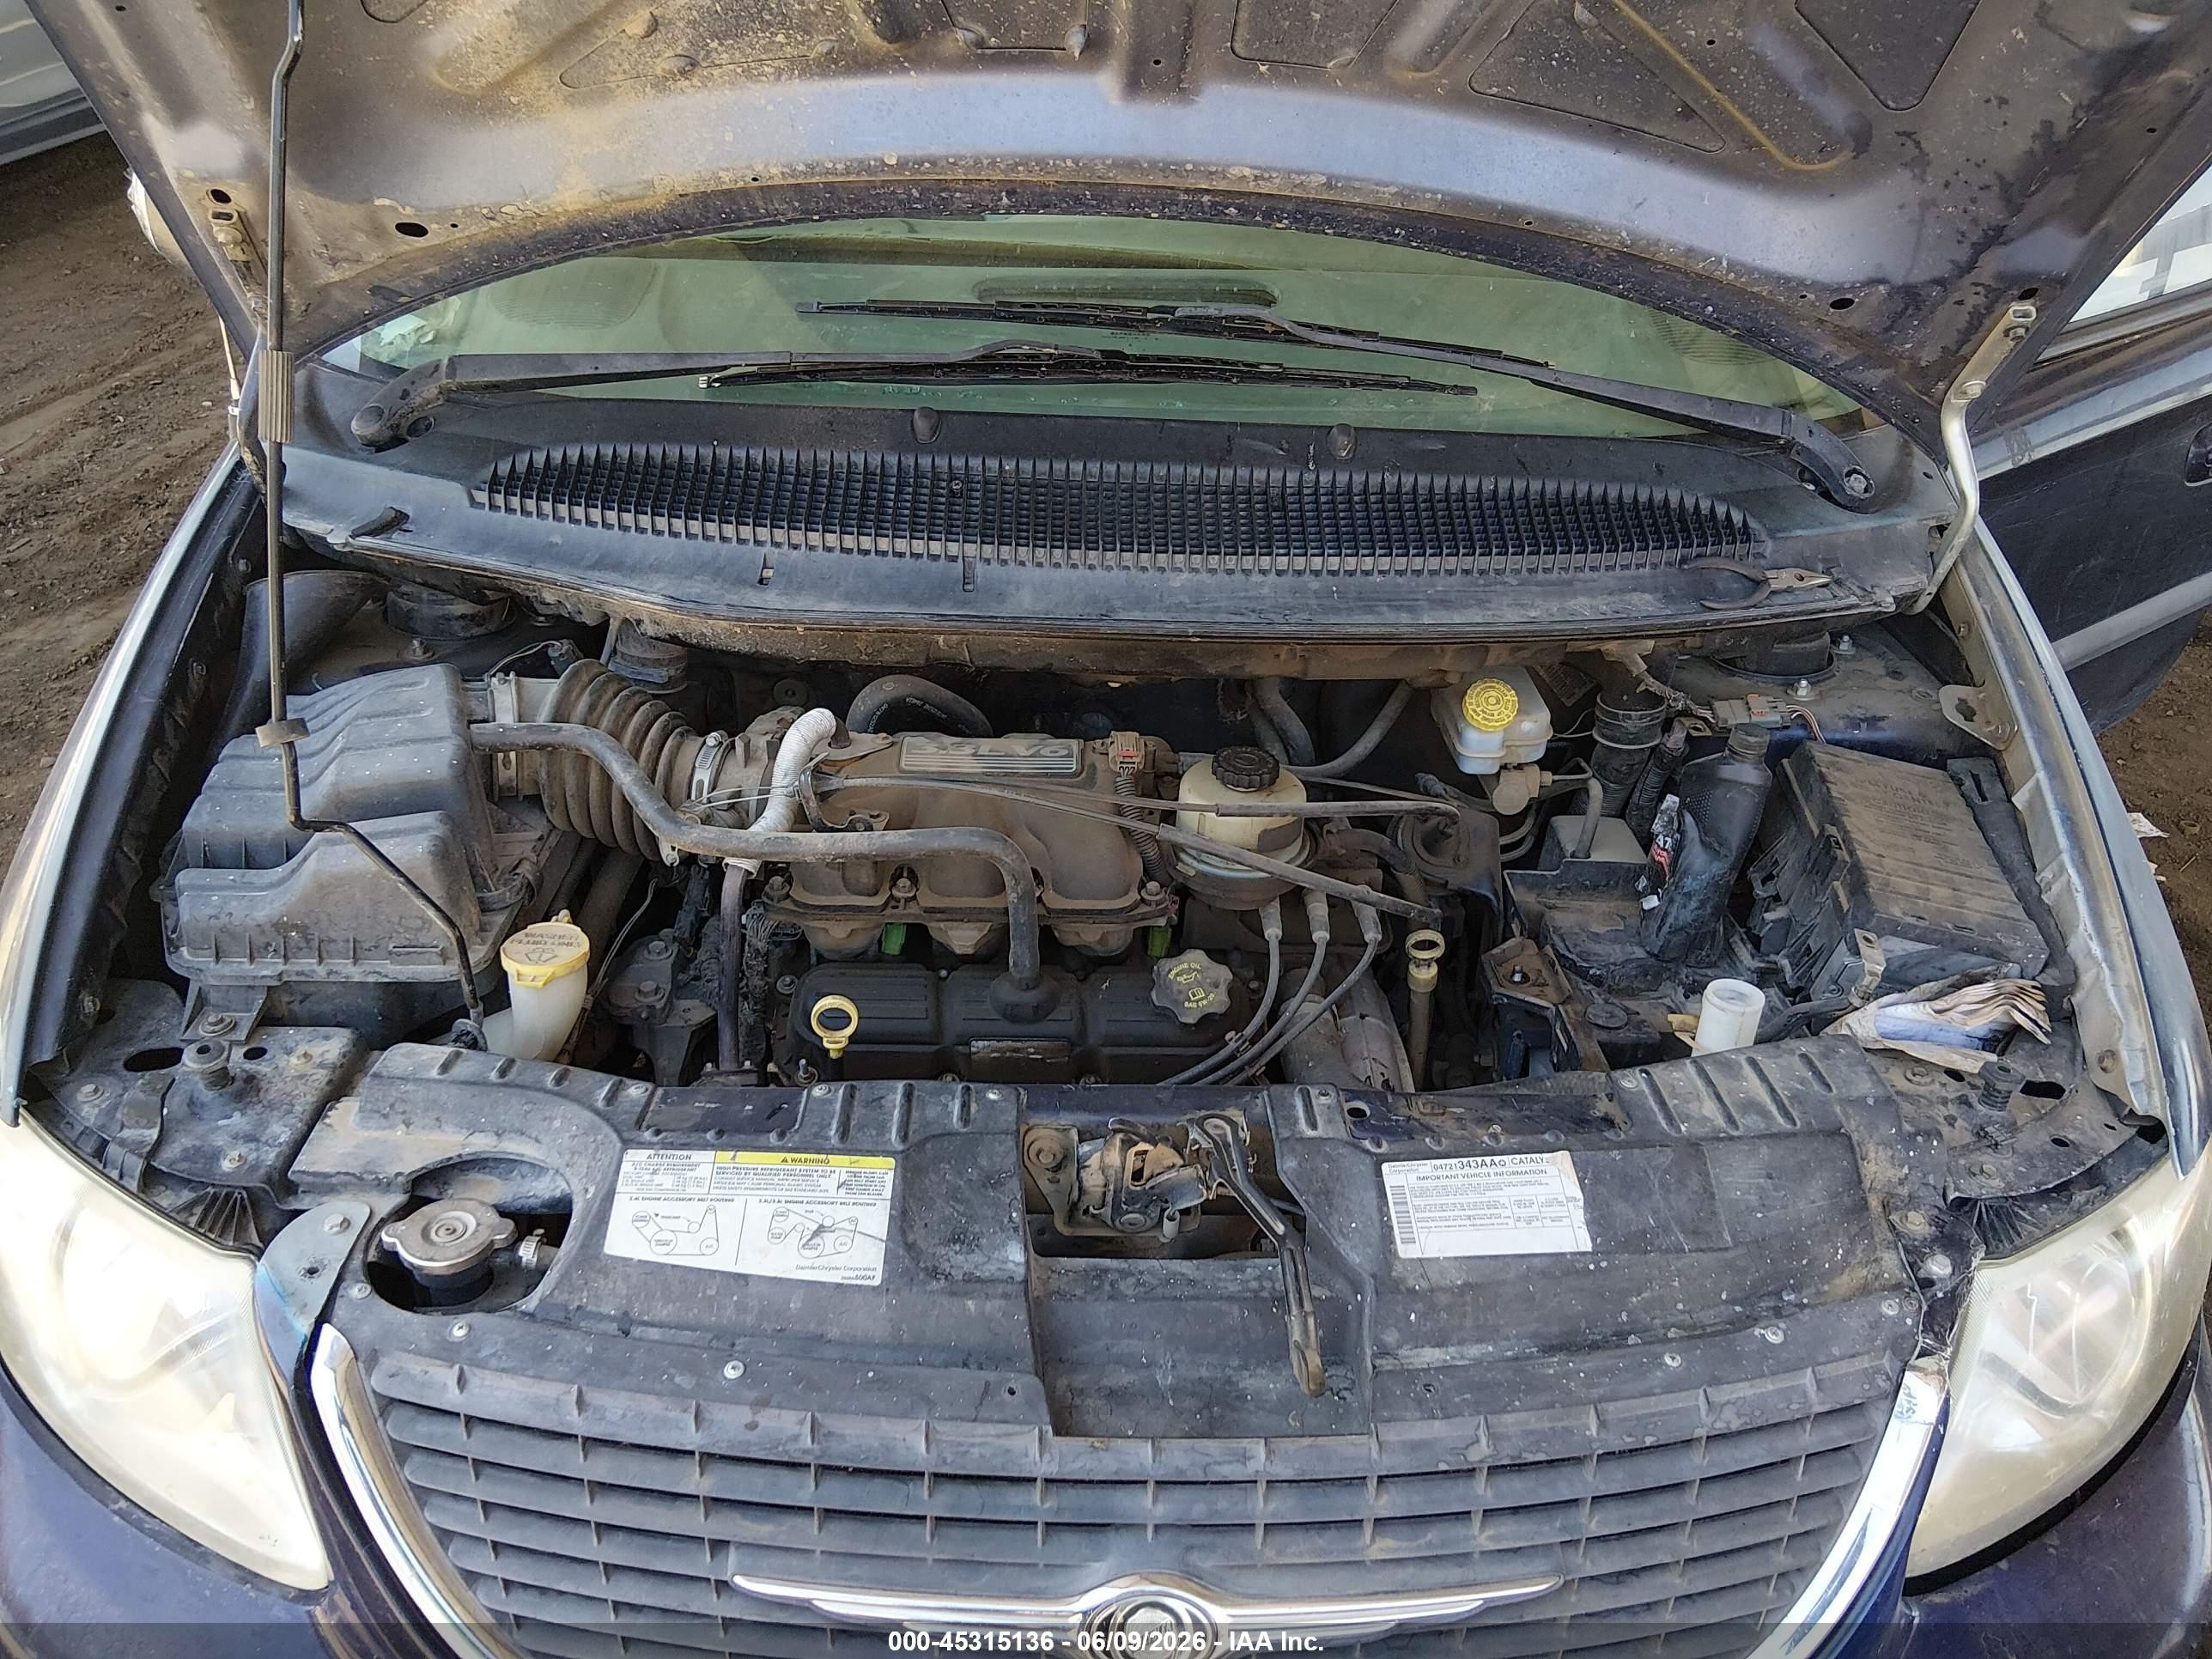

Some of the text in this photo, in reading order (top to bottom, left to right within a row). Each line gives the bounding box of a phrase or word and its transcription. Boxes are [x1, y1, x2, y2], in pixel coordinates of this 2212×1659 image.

[1011, 744, 1069, 757] V6
[525, 932, 579, 940] WASHER
[1168, 962, 1189, 980] ENGINE
